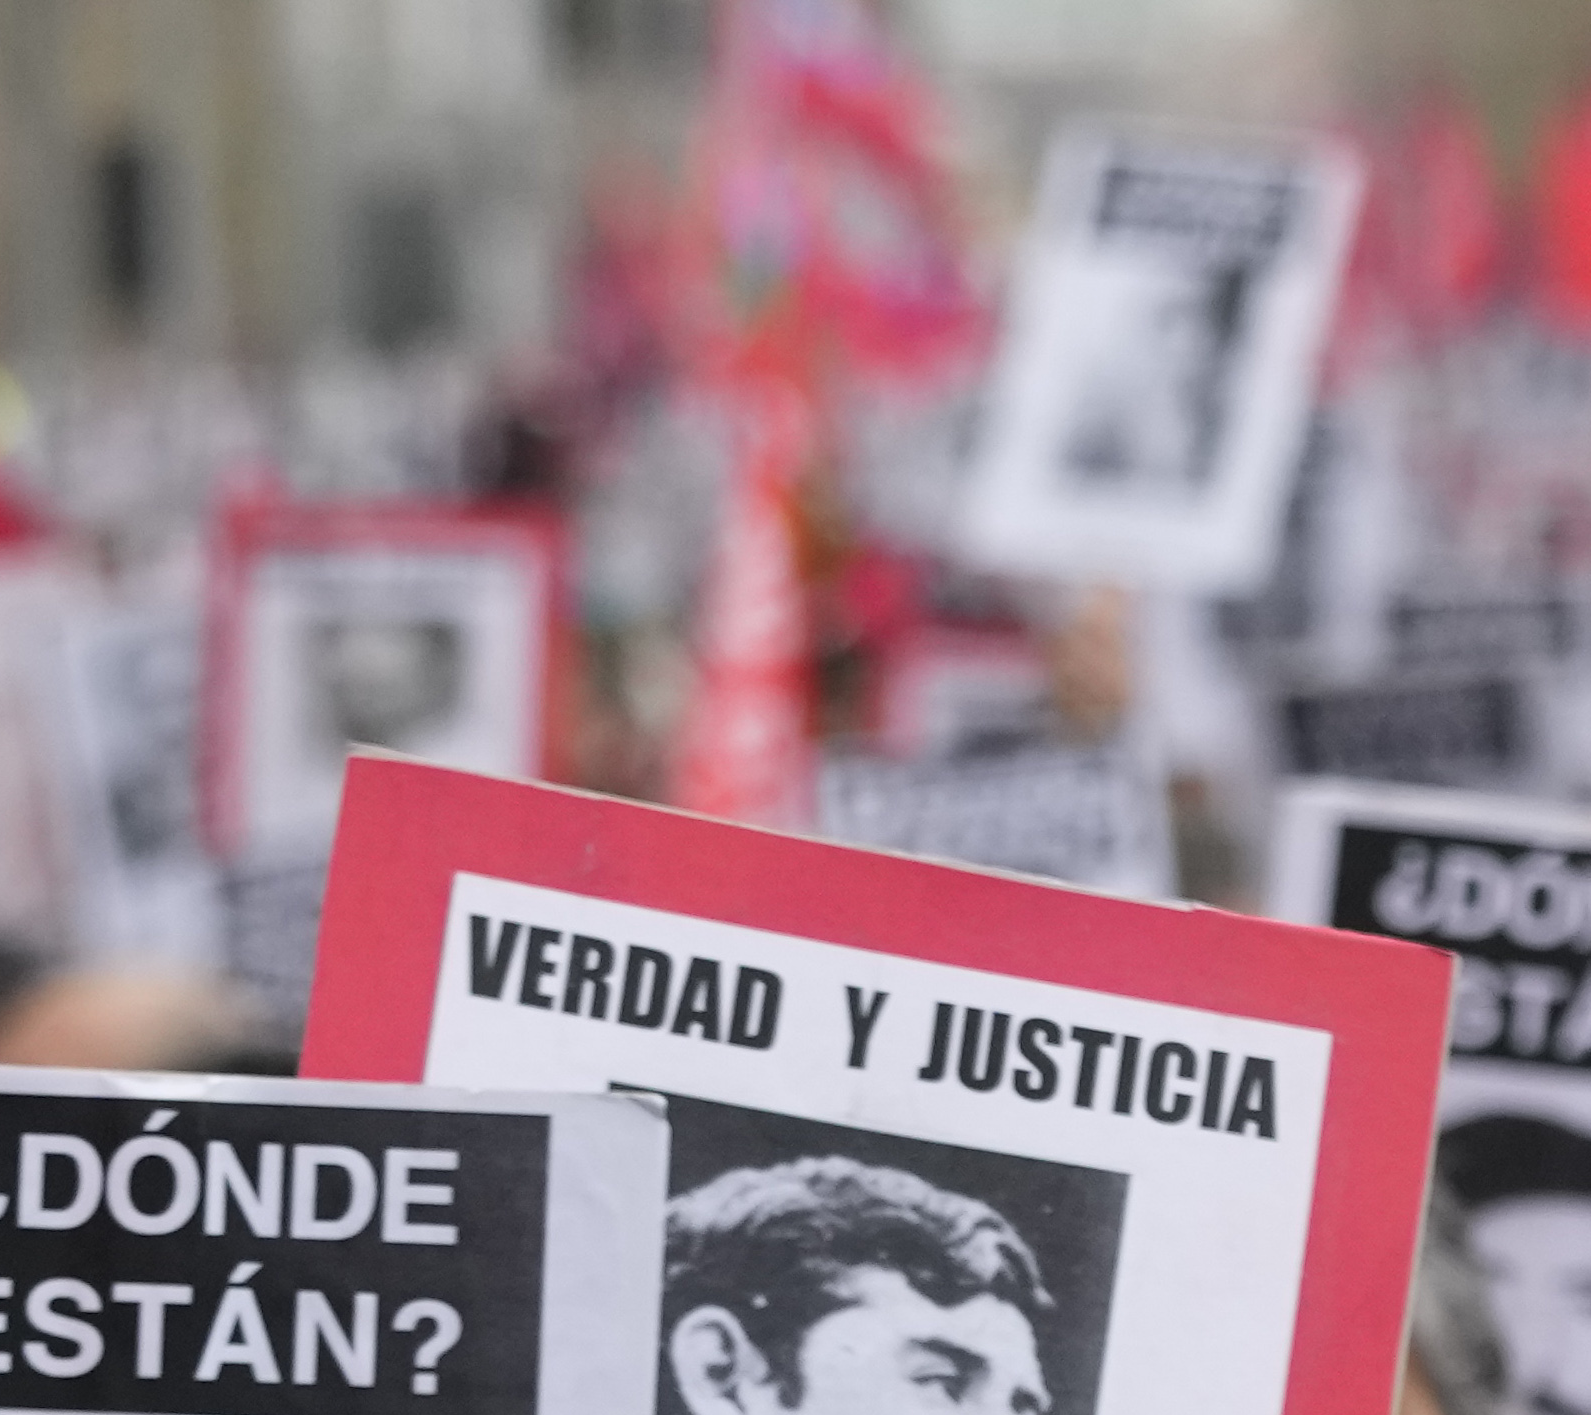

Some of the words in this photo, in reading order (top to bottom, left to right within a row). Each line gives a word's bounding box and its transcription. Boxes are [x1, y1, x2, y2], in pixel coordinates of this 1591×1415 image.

[469, 914, 783, 1052] VERDAD
[845, 985, 891, 1068] Y
[917, 1000, 1279, 1142] JUSTICIA
